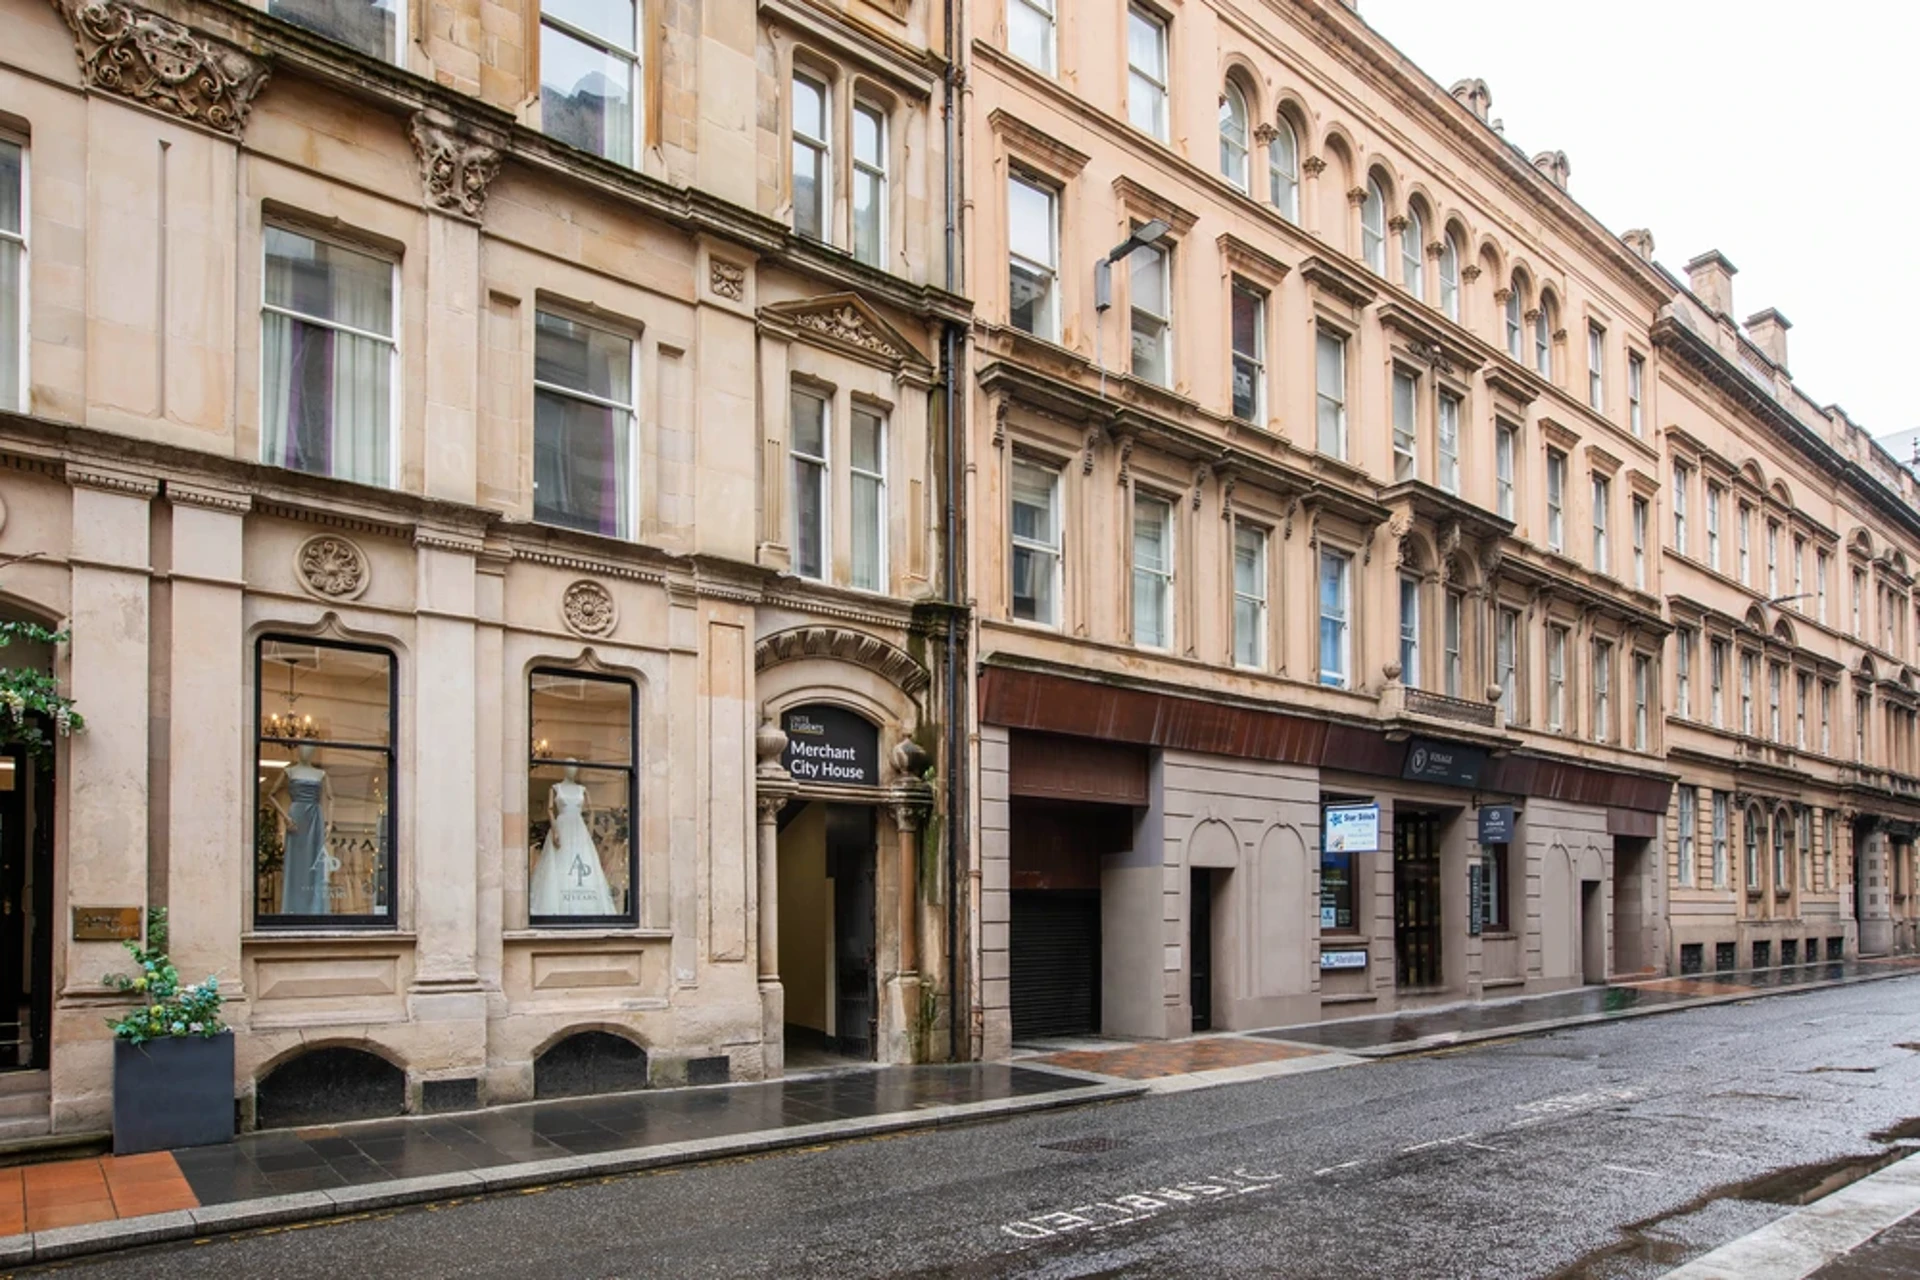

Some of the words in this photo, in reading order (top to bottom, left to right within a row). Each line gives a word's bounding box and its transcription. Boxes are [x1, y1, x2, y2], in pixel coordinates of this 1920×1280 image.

[790, 740, 856, 760] Merchant
[790, 759, 819, 778] City
[822, 762, 864, 780] House
